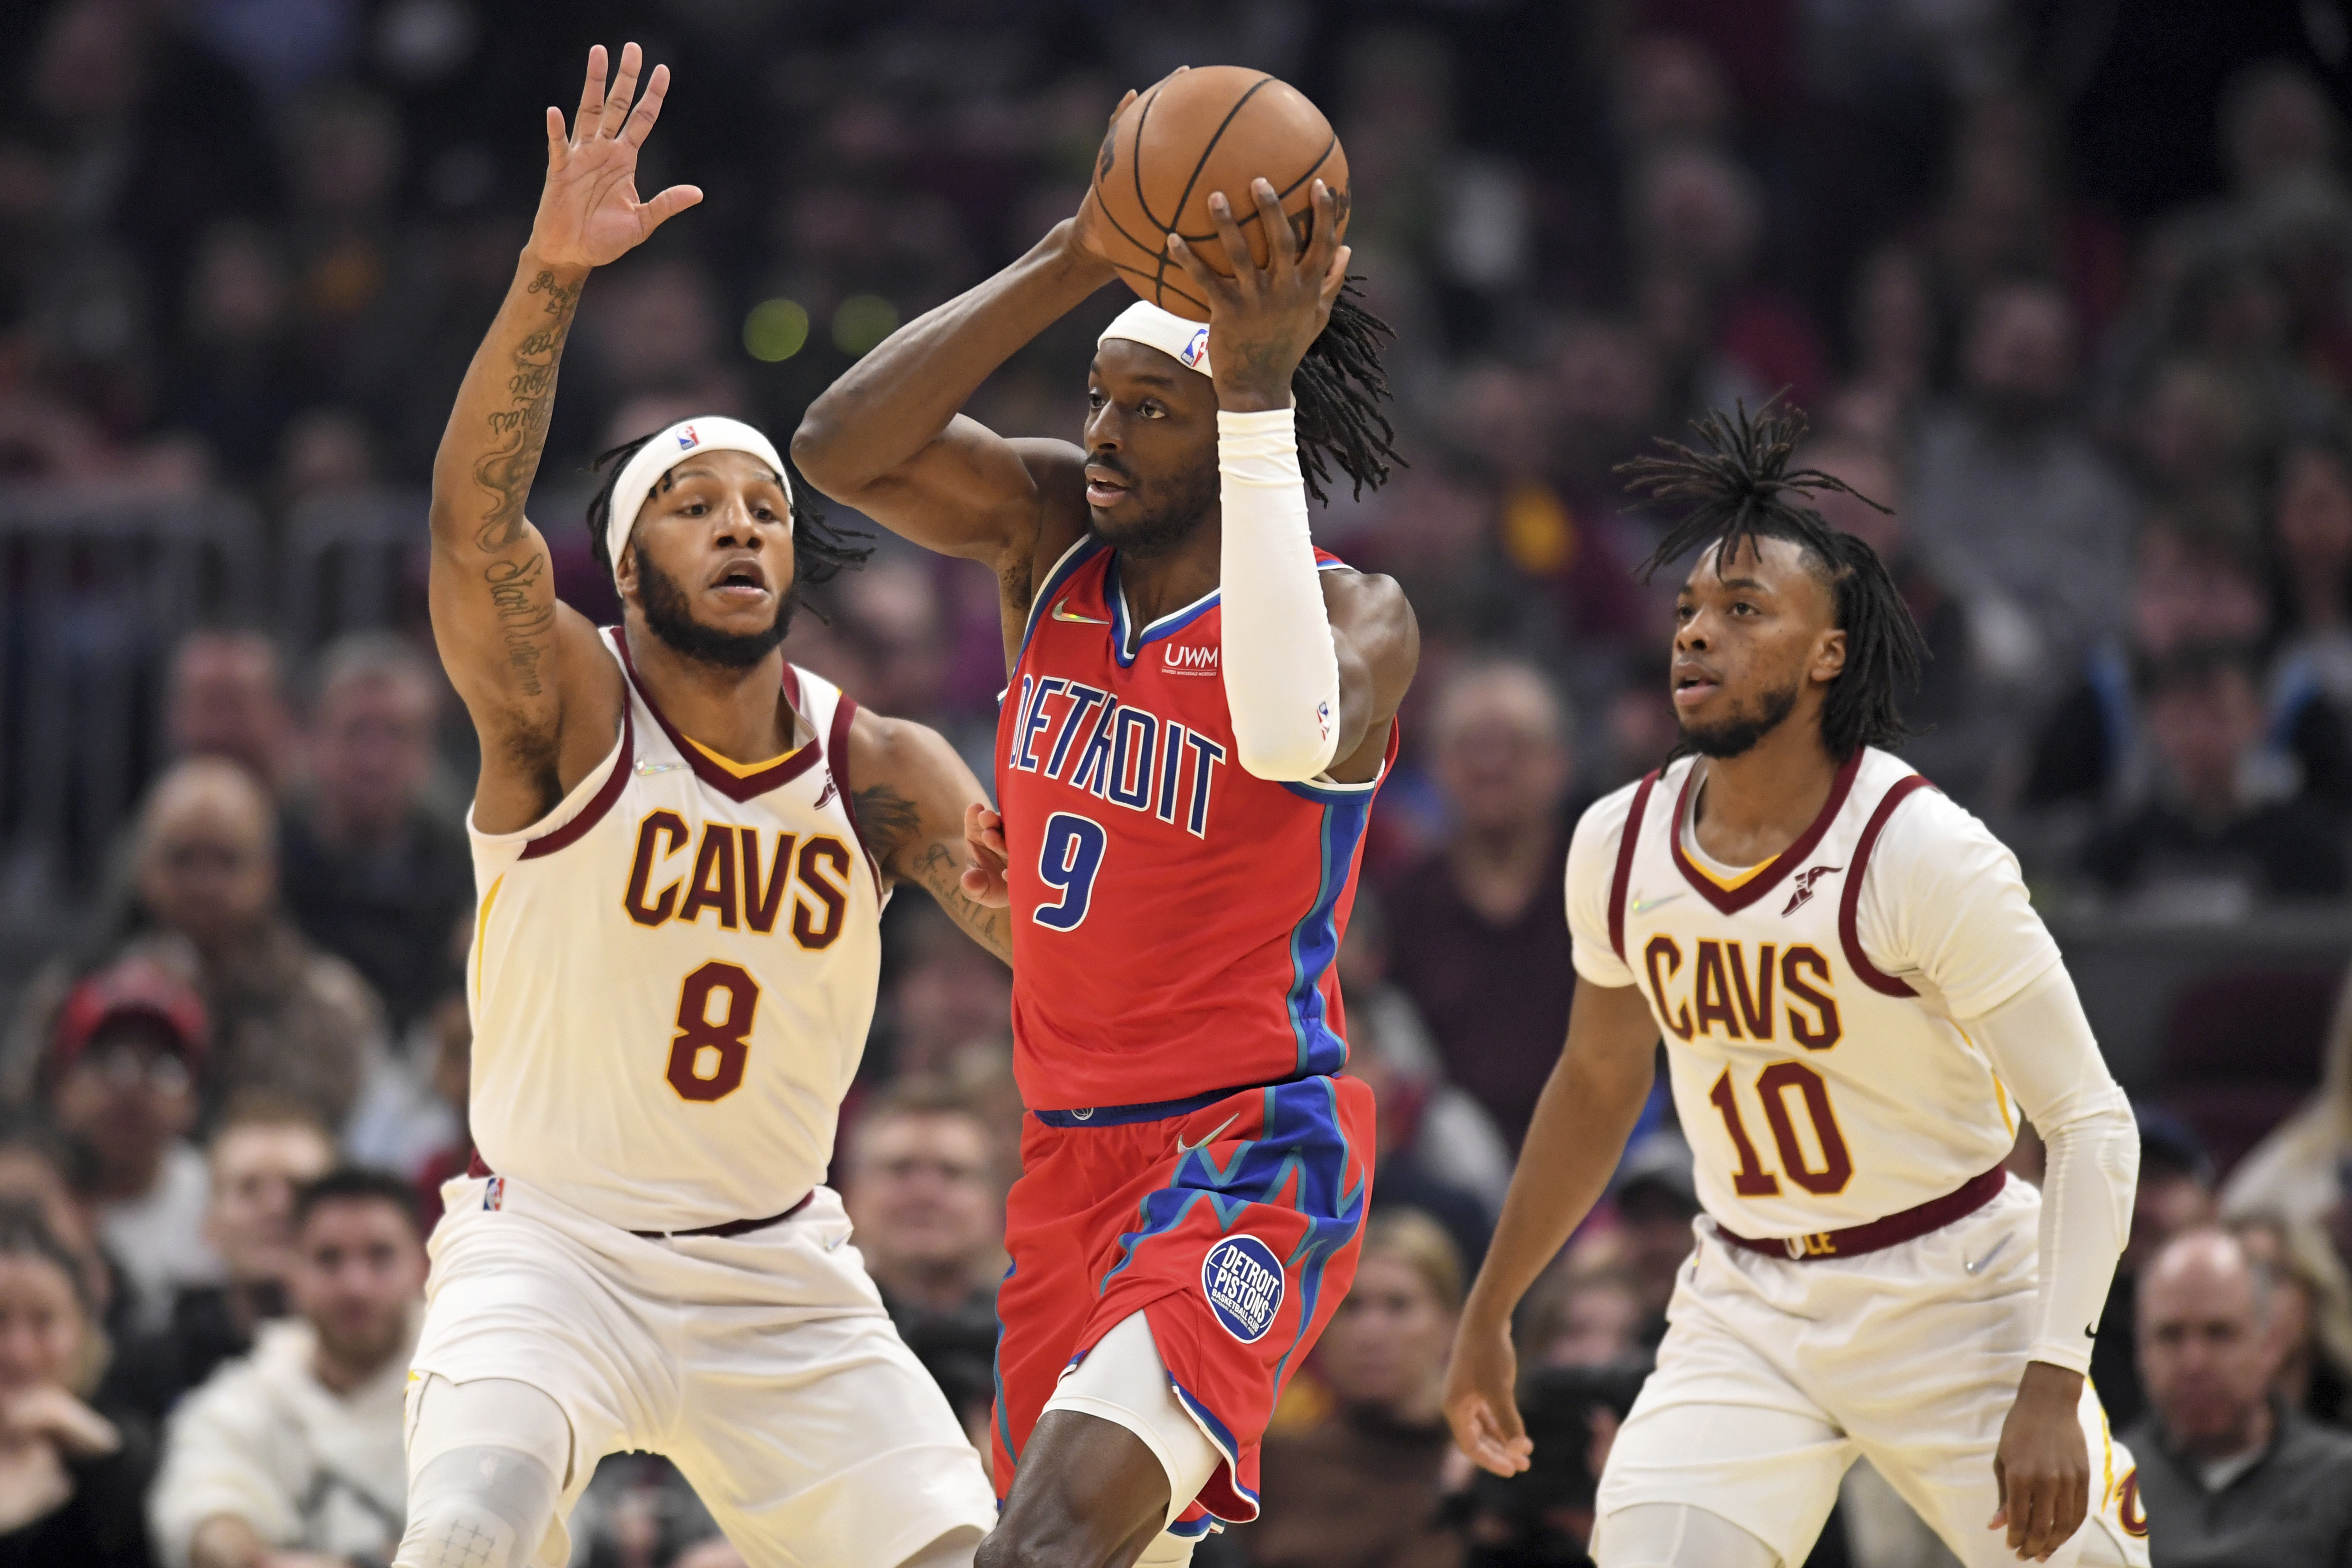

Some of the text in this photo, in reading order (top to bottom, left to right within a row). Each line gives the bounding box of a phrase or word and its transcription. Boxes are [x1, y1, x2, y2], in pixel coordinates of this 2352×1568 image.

[1165, 643, 1219, 668] UWM
[1009, 673, 1227, 840] DETROIT
[622, 807, 854, 953] CAVS
[1032, 811, 1108, 932] 9
[664, 958, 763, 1104] 8
[1644, 932, 1844, 1053] CAVS
[1709, 1058, 1855, 1198] 10
[1211, 1287, 1259, 1333] BASKETBALL CLUB
[1214, 1266, 1270, 1324] PISTONS
[1221, 1244, 1280, 1301] DETROIT
